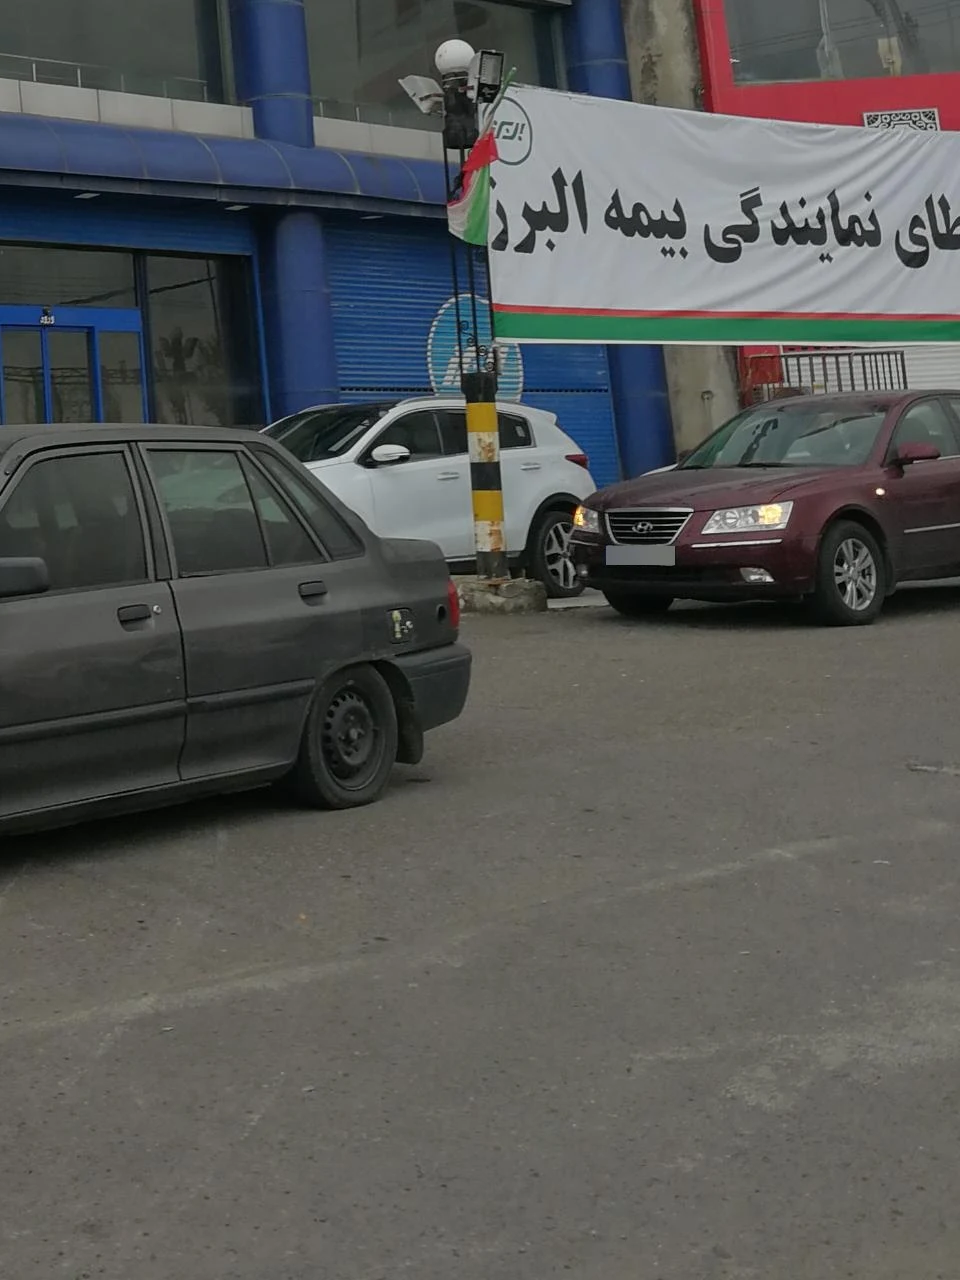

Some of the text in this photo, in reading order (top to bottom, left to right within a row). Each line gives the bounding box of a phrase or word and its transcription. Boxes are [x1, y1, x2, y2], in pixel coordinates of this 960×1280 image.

[490, 167, 588, 254] البرز
[604, 188, 688, 259] بیمه
[704, 186, 882, 263] نمایندگی
